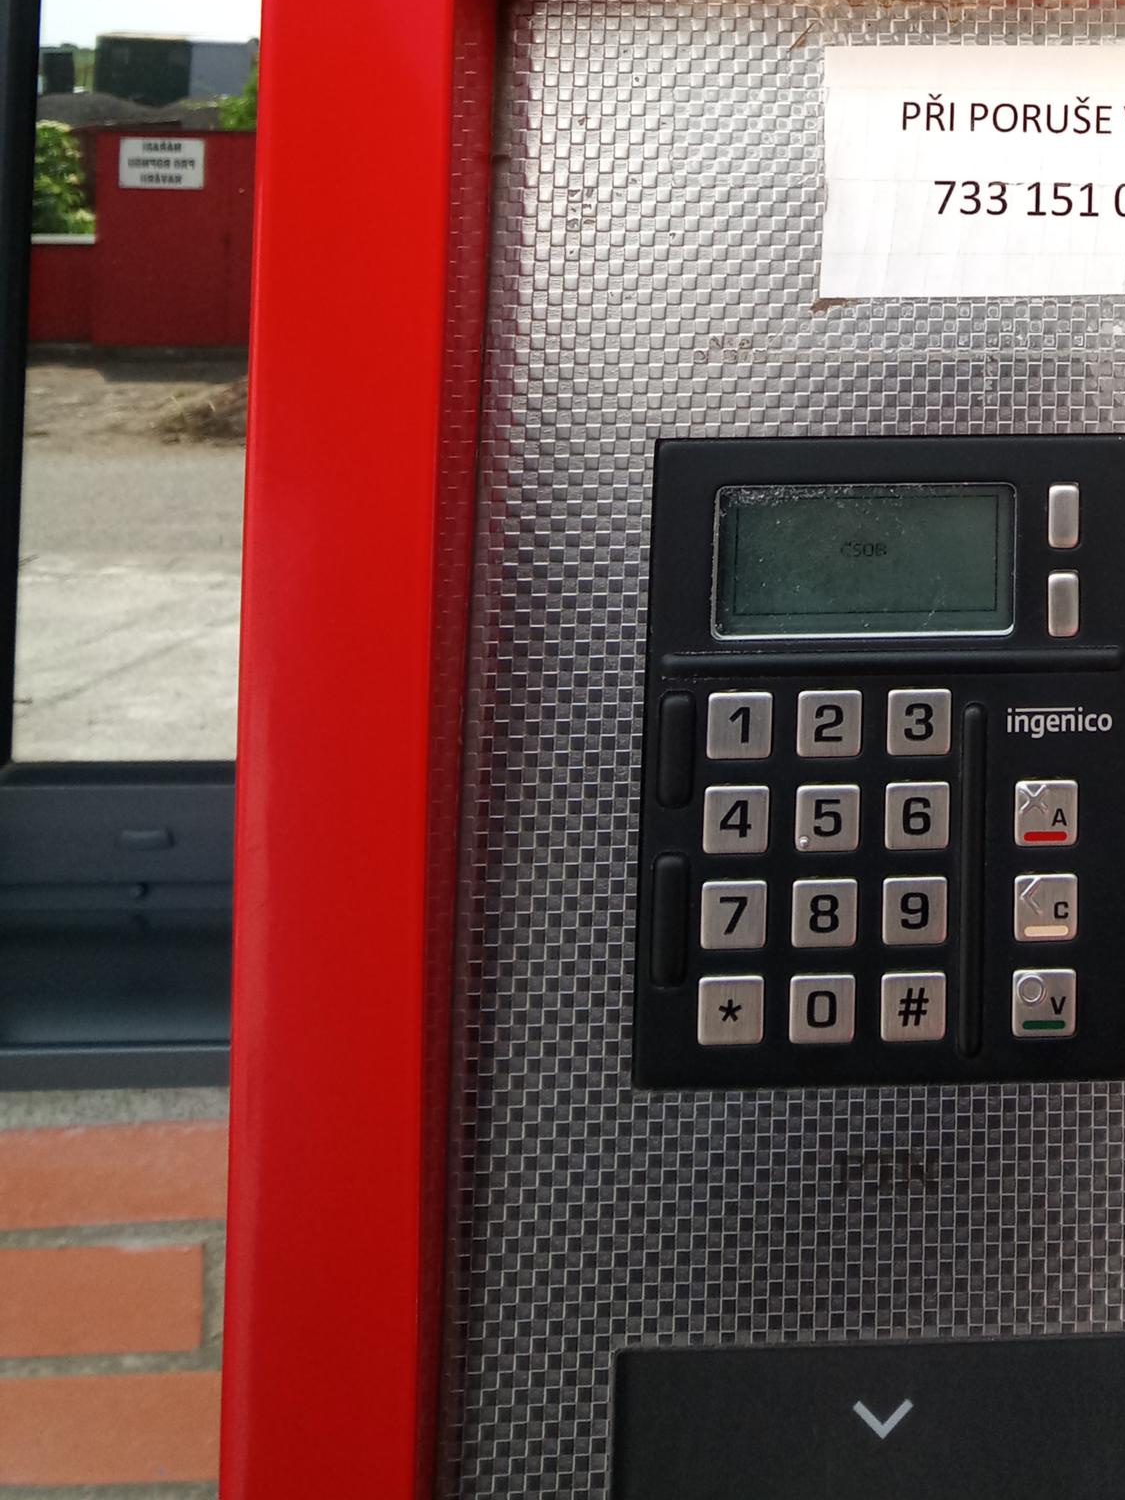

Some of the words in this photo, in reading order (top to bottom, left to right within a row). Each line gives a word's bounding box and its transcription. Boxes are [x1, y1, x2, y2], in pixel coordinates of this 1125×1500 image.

[901, 93, 955, 131] PŘI
[970, 96, 1112, 135] PORUŠE
[934, 180, 1008, 216] 733
[1026, 182, 1100, 218] 151
[728, 706, 751, 744] 1
[813, 704, 845, 743] 2
[904, 703, 934, 742] 3
[1006, 707, 1112, 738] ingenico
[719, 799, 752, 838] 4
[812, 798, 843, 837] 5
[902, 796, 932, 836] 6
[1052, 808, 1067, 827] A
[718, 896, 749, 936] 7
[808, 894, 839, 933] 8
[900, 892, 930, 930] 9
[1054, 901, 1069, 919] C
[806, 990, 837, 1028] 0
[898, 987, 929, 1026] #
[1050, 996, 1067, 1014] V
